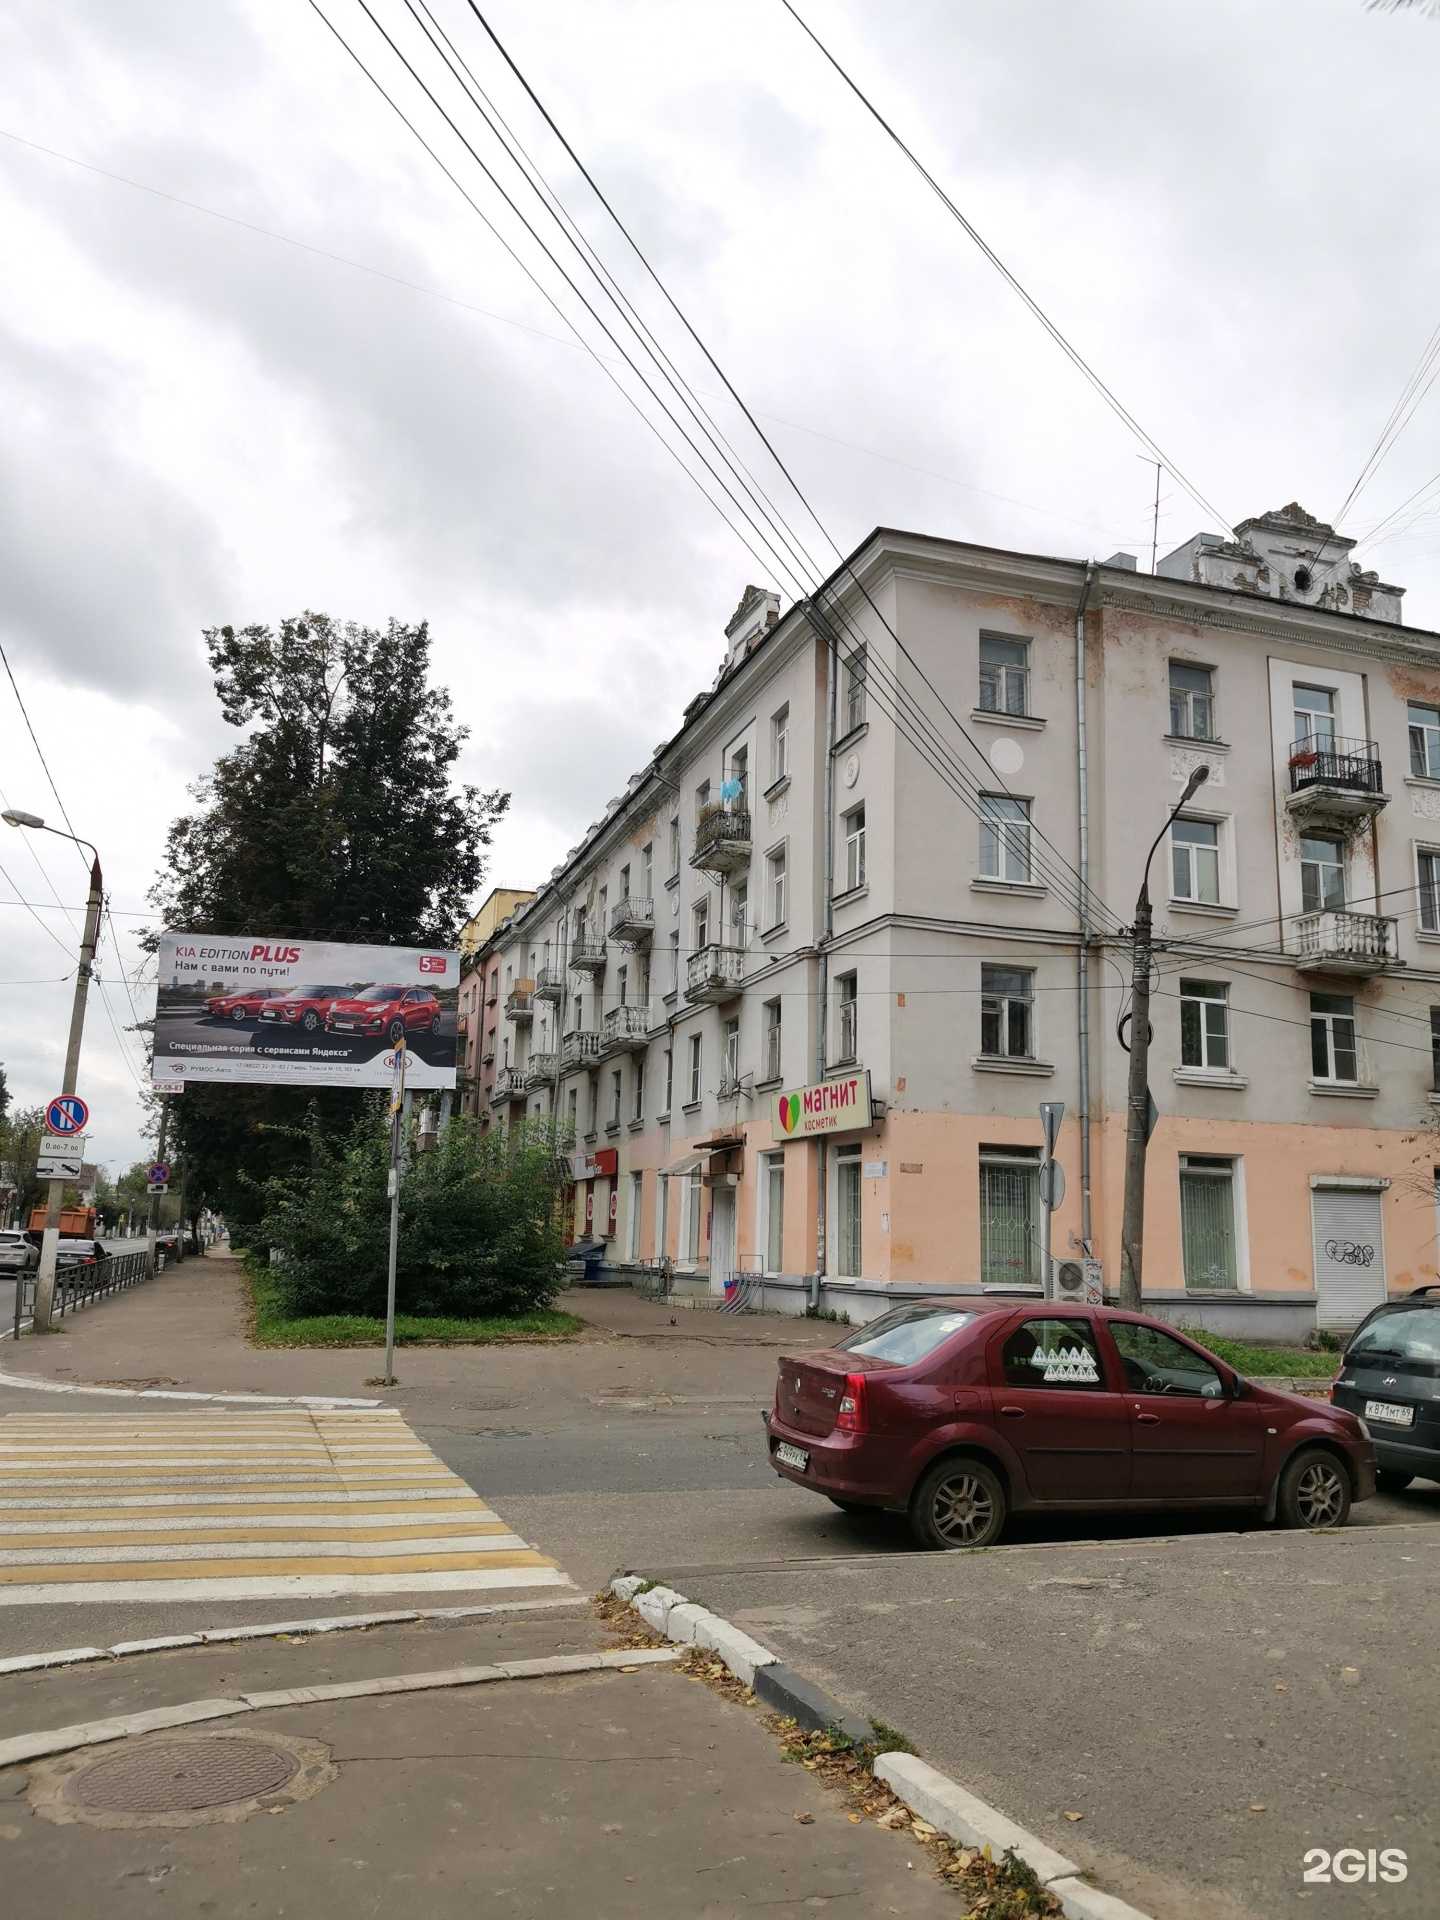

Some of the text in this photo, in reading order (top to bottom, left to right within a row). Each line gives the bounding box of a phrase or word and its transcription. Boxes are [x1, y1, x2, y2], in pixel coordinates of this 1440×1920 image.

[175, 945, 301, 963] KIA EDITION PLUS
[175, 960, 290, 977] Нам с вами по пути!
[421, 957, 431, 971] 5
[169, 1041, 228, 1052] Специальная
[229, 1046, 255, 1054] серия
[264, 1047, 310, 1056] сервисами
[312, 1048, 348, 1058] Яндекса
